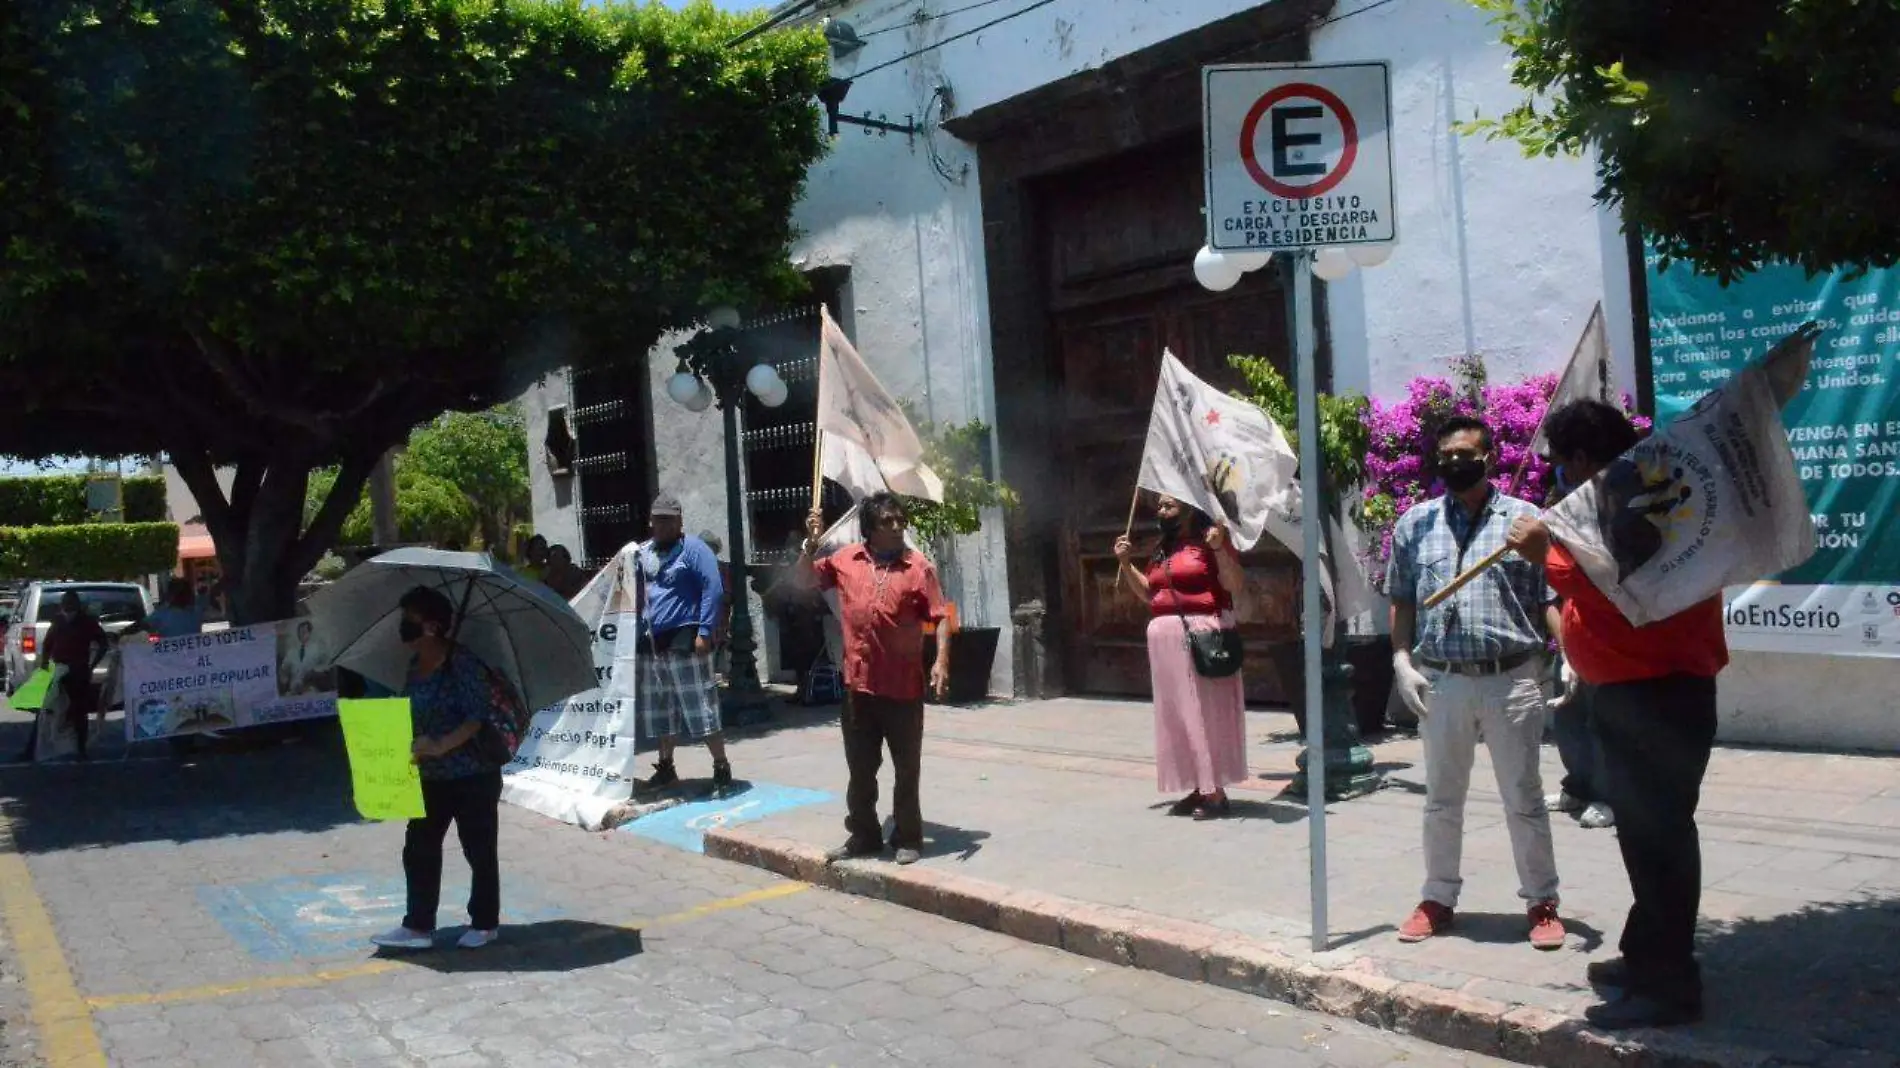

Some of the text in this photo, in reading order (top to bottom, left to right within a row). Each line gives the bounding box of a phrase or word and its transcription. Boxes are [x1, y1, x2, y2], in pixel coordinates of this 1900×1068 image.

[1272, 106, 1326, 177] E
[1243, 195, 1361, 214] EXCLUSIVO
[1224, 209, 1379, 231] CARGA Y DESCARGA
[1246, 226, 1368, 244] PRESIDENCIA
[1743, 309, 1754, 319] a
[1844, 293, 1878, 310] que
[1721, 326, 1746, 341] los
[1674, 346, 1731, 363] familia
[1743, 348, 1753, 361] y
[1830, 336, 1861, 348] con
[1700, 368, 1732, 383] que
[1818, 373, 1887, 393] Unidos.
[1784, 425, 1849, 442] VENGA
[1855, 422, 1879, 438] EN
[1801, 465, 1823, 480] DE
[1841, 512, 1866, 528] TU
[154, 628, 257, 654] RESPETO TOTAL
[197, 655, 213, 668] AL
[139, 665, 271, 696] COMERCIO POPULAR
